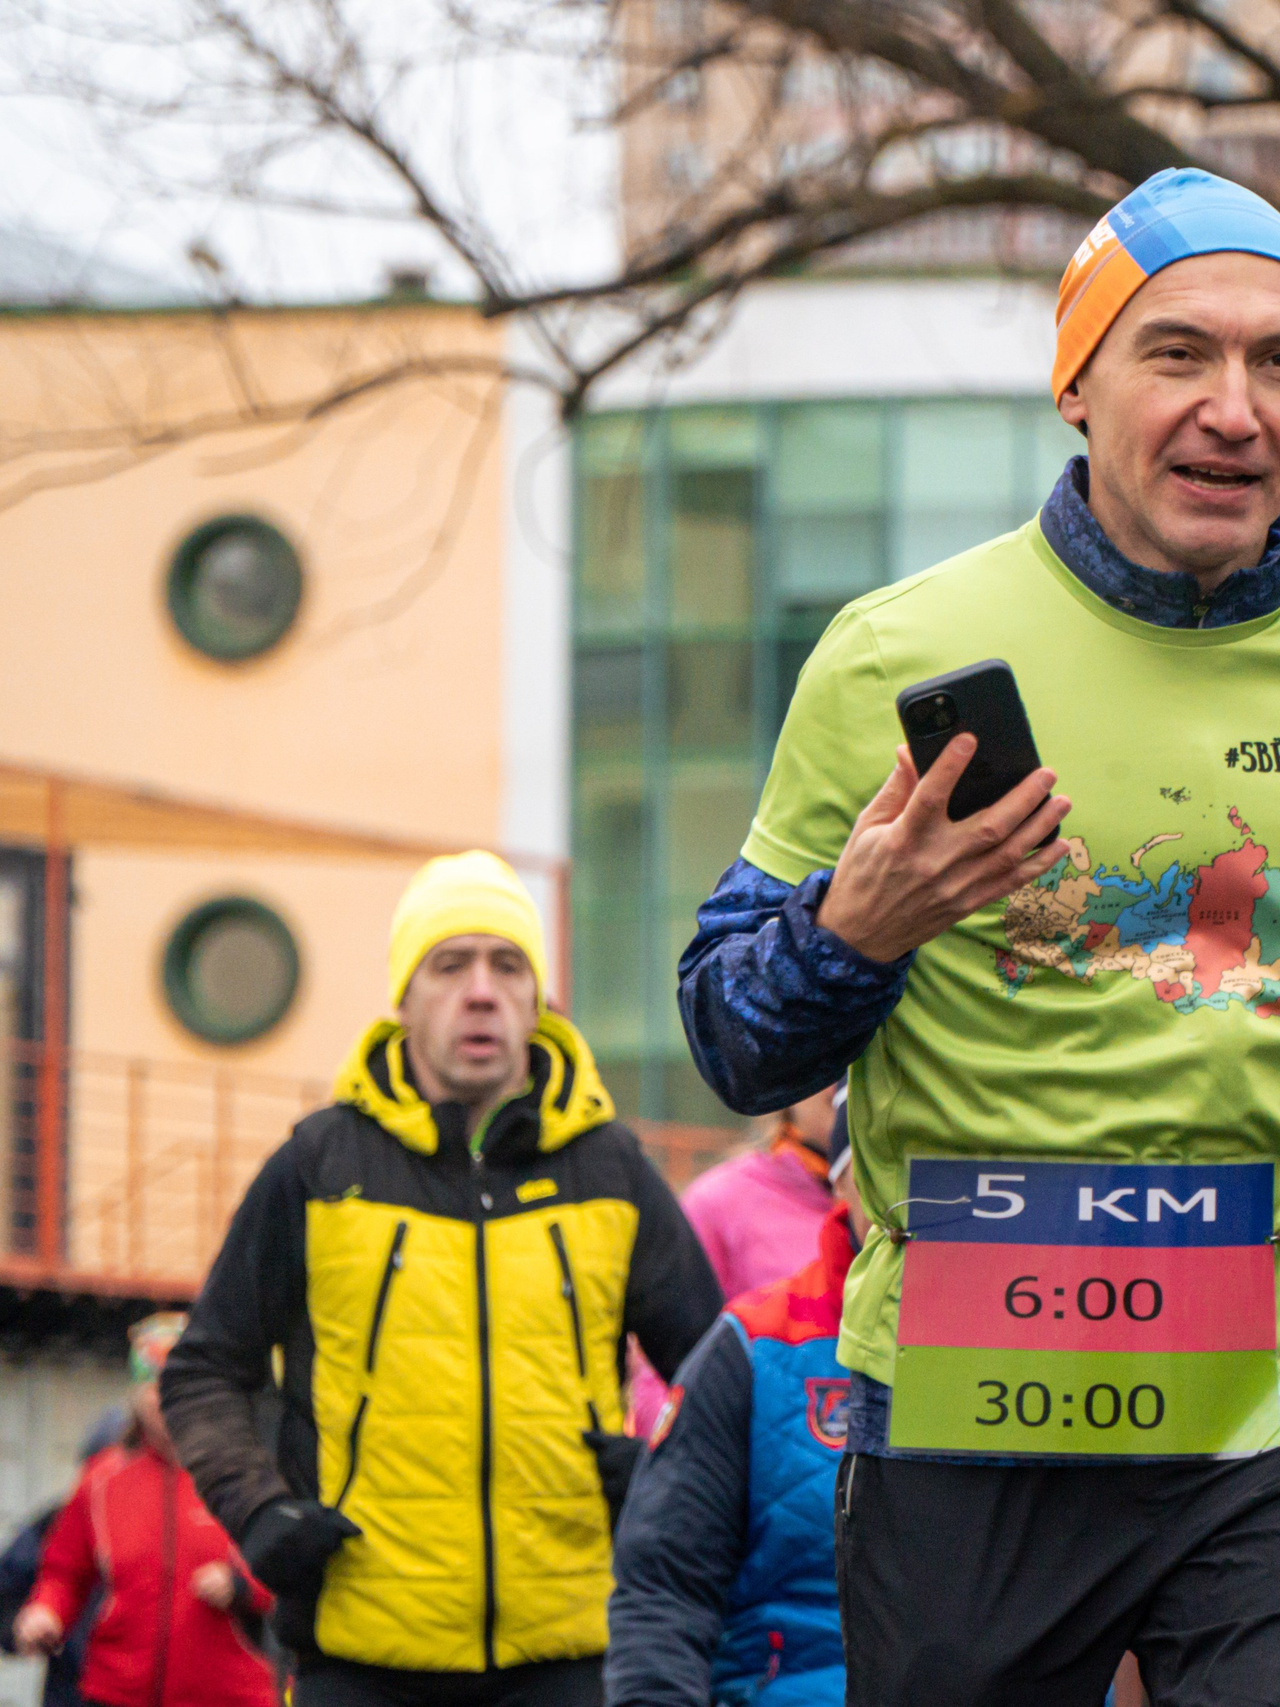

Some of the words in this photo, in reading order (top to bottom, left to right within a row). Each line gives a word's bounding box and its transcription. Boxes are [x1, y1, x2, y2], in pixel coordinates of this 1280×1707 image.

[972, 1174, 1025, 1219] 5
[1004, 1275, 1163, 1321] 6:00
[975, 1380, 1165, 1429] 30:00
